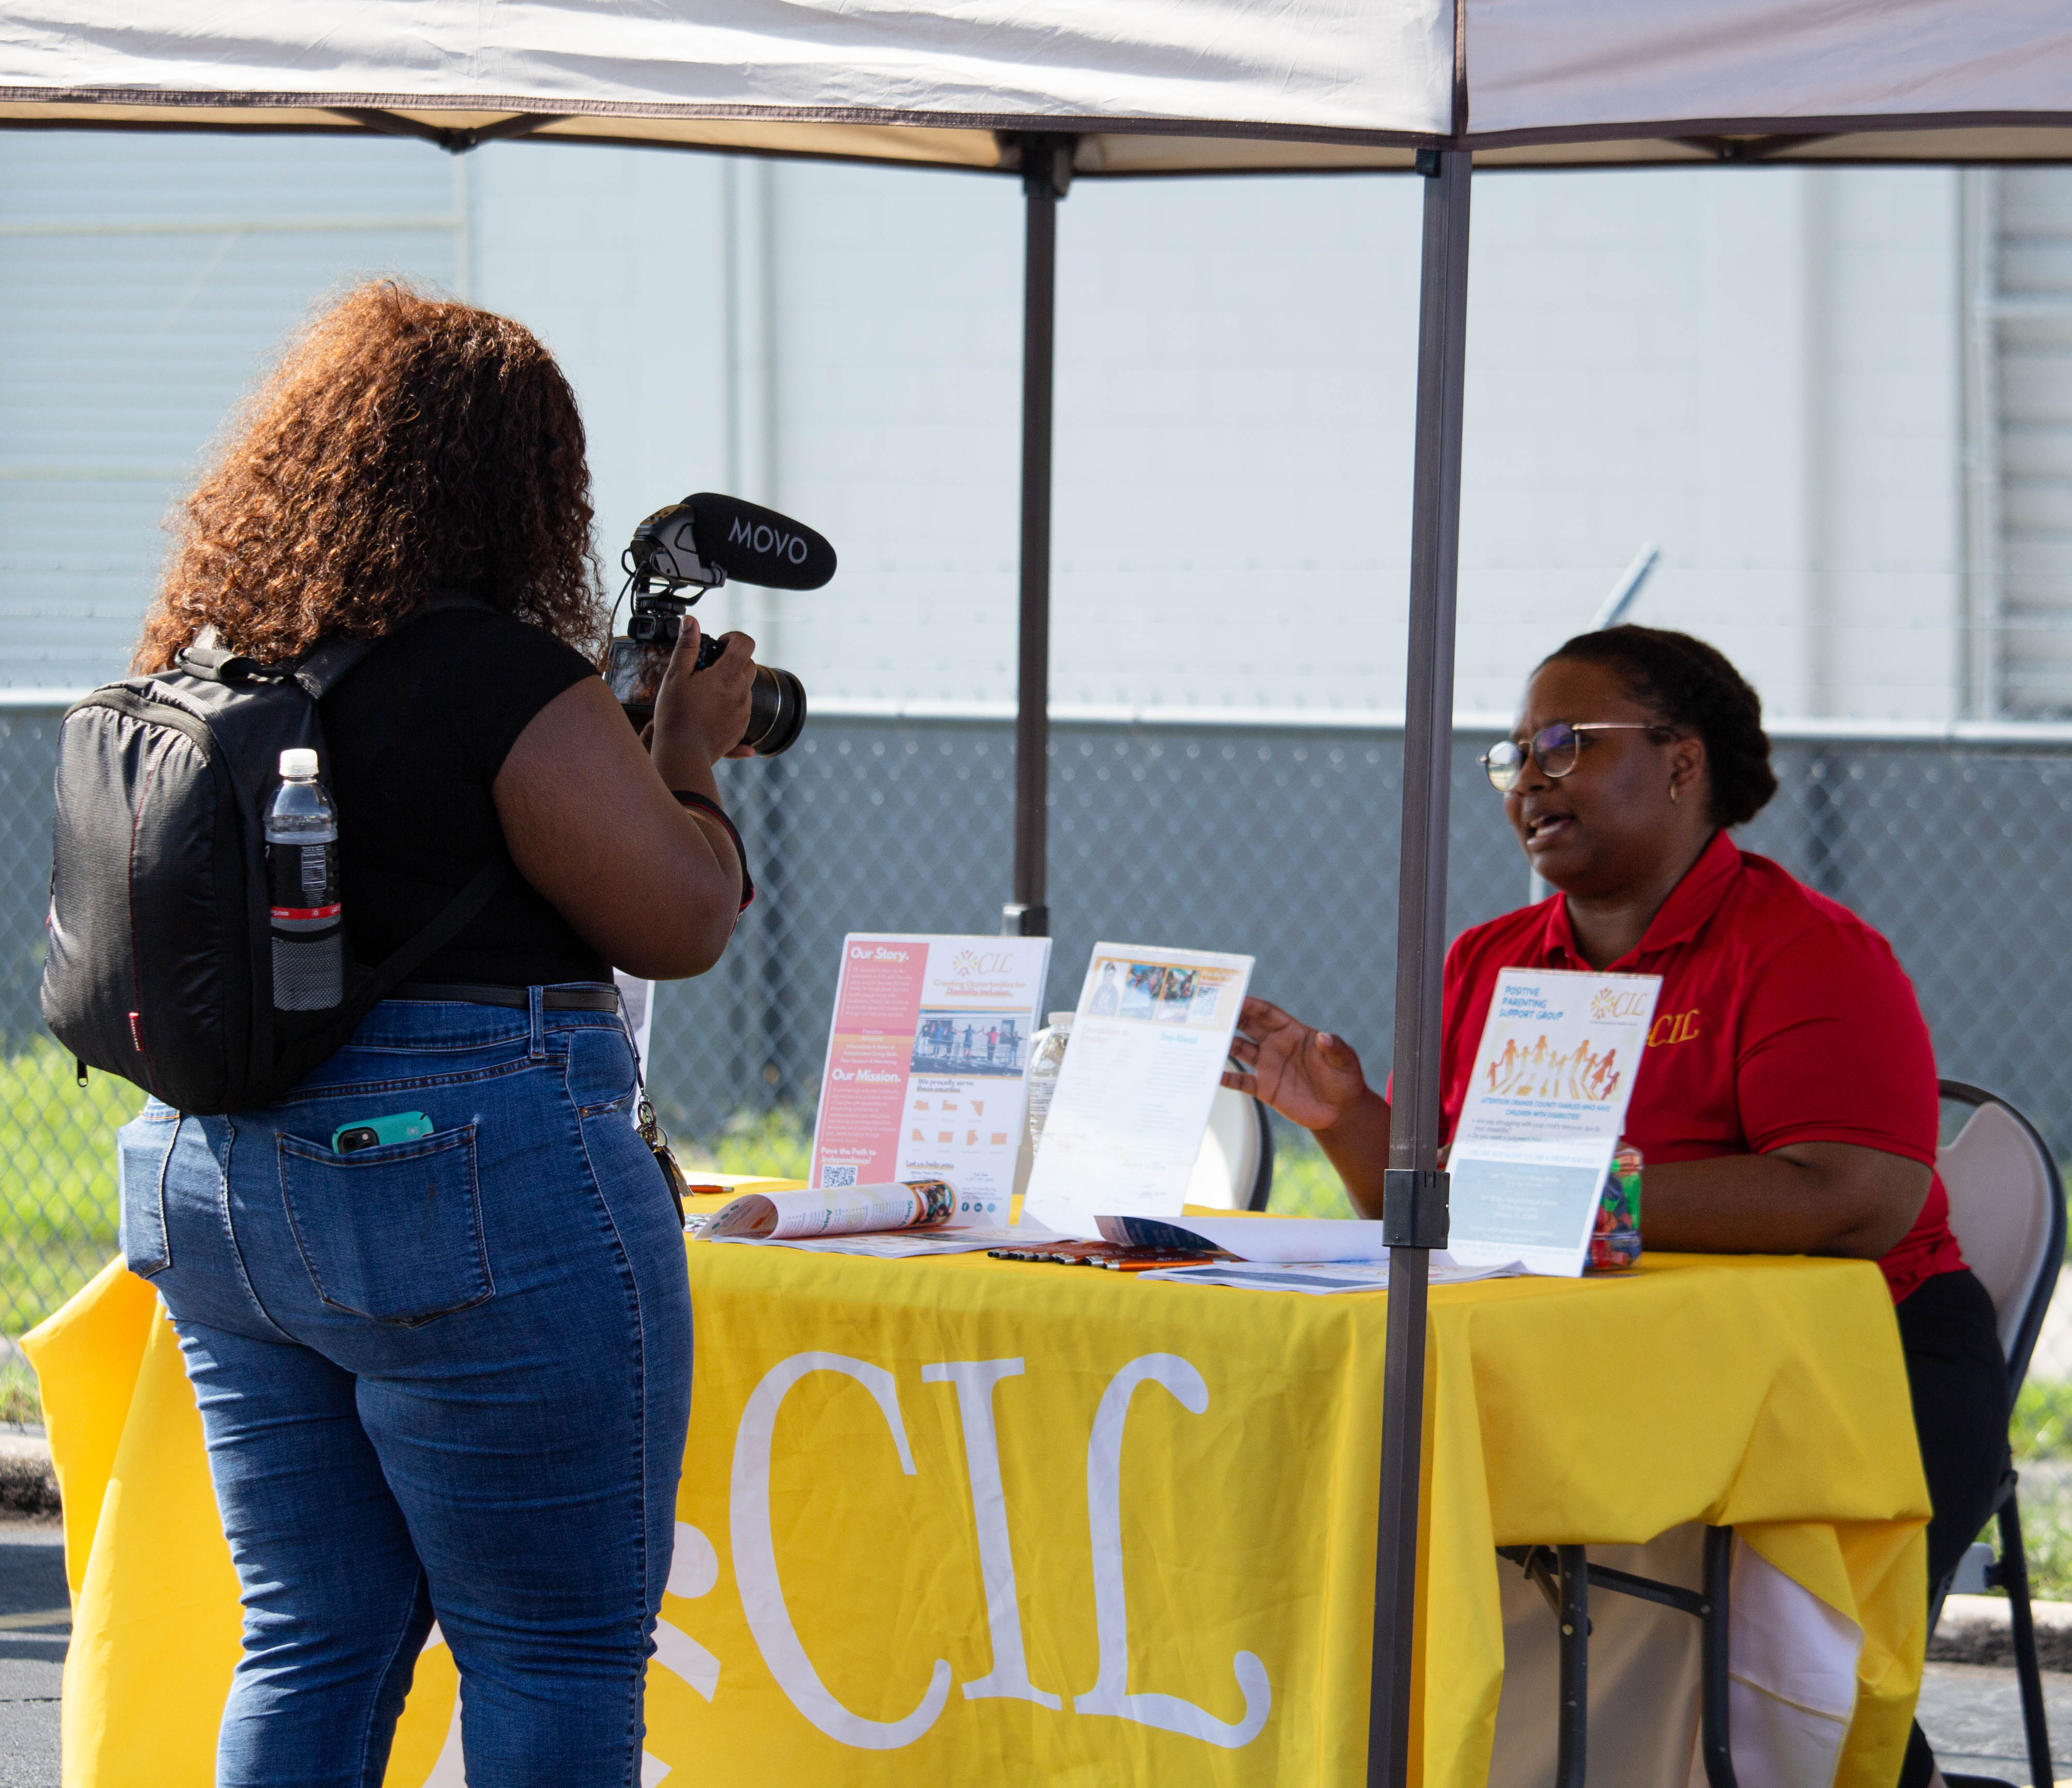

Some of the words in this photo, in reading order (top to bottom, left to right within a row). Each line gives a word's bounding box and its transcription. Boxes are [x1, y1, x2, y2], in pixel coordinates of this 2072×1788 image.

[728, 517, 808, 564] MOVO
[850, 946, 874, 960] Our
[875, 947, 910, 963] Story.
[978, 952, 1014, 975] CIL
[1505, 985, 1540, 997] POSITIVE
[1502, 997, 1547, 1008] PARENTING
[1612, 992, 1647, 1018] CIL
[1499, 1009, 1534, 1019] SUPPORT
[1536, 1010, 1564, 1021] GROUP
[1648, 1008, 1700, 1047] CIL
[832, 1068, 855, 1081] Our
[855, 1069, 901, 1082] Mission.
[730, 1351, 1271, 1749] CIL
